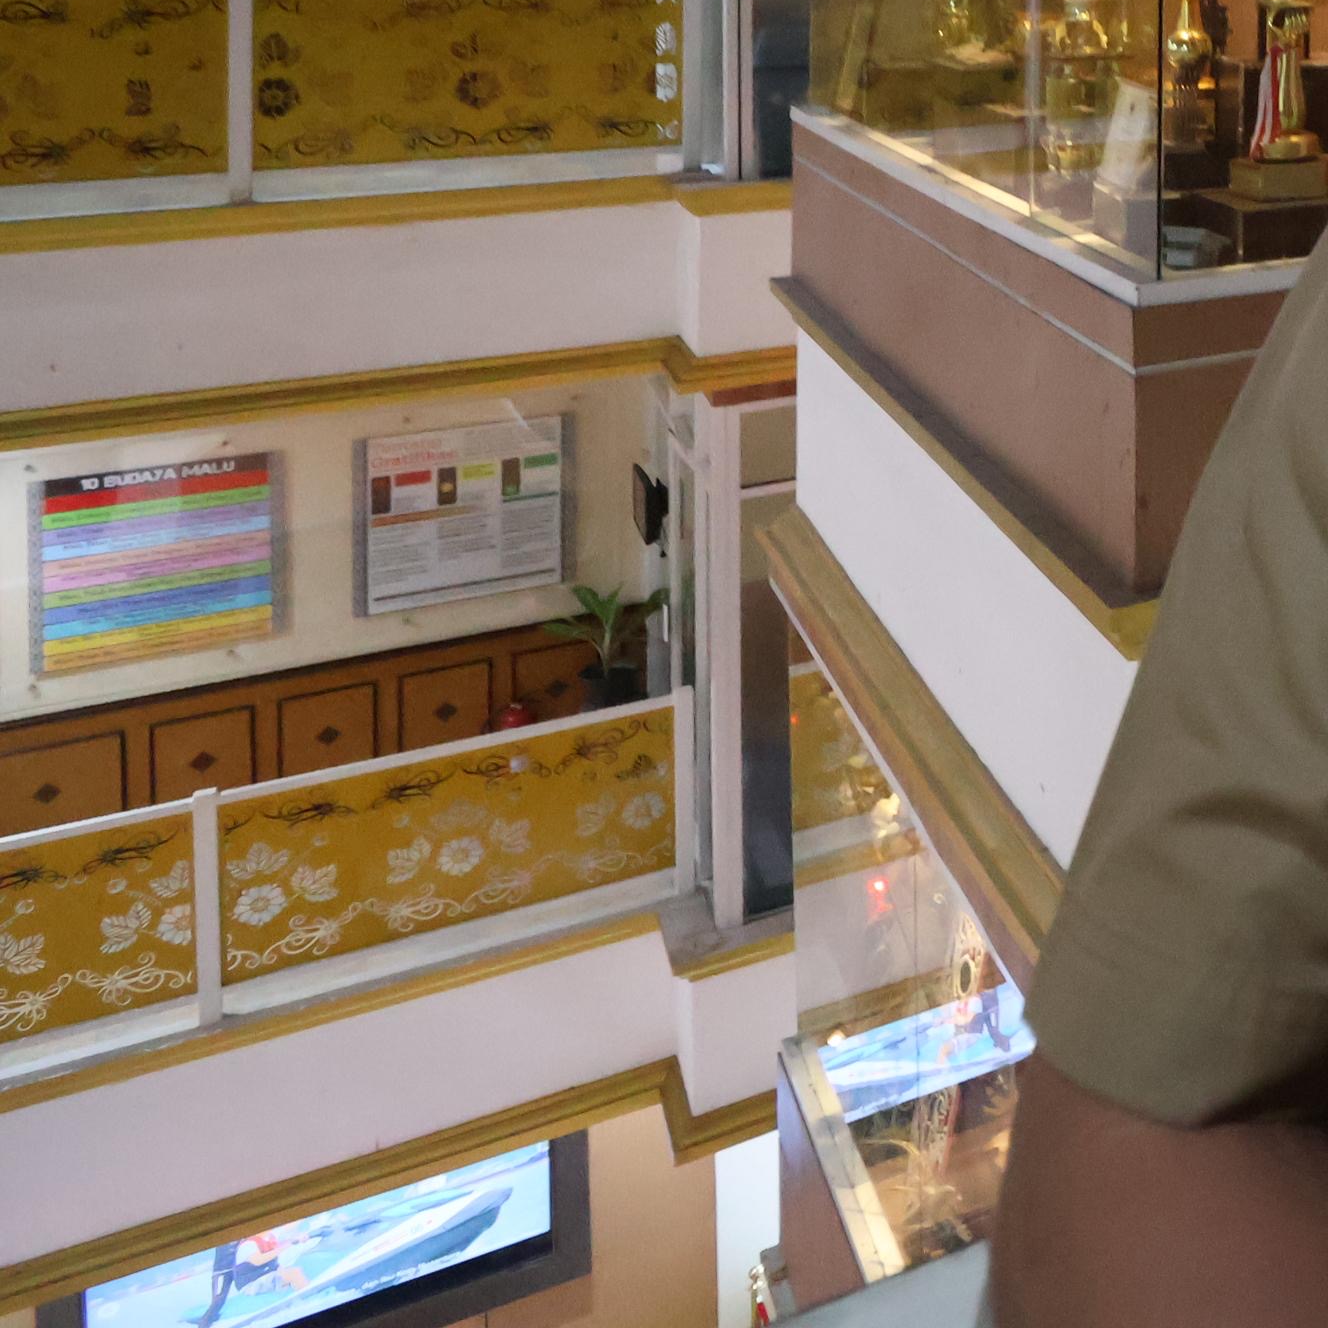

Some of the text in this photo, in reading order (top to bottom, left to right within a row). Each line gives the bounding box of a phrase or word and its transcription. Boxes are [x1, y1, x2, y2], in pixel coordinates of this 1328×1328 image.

[80, 460, 235, 491] 10 BUDAYA MALU
